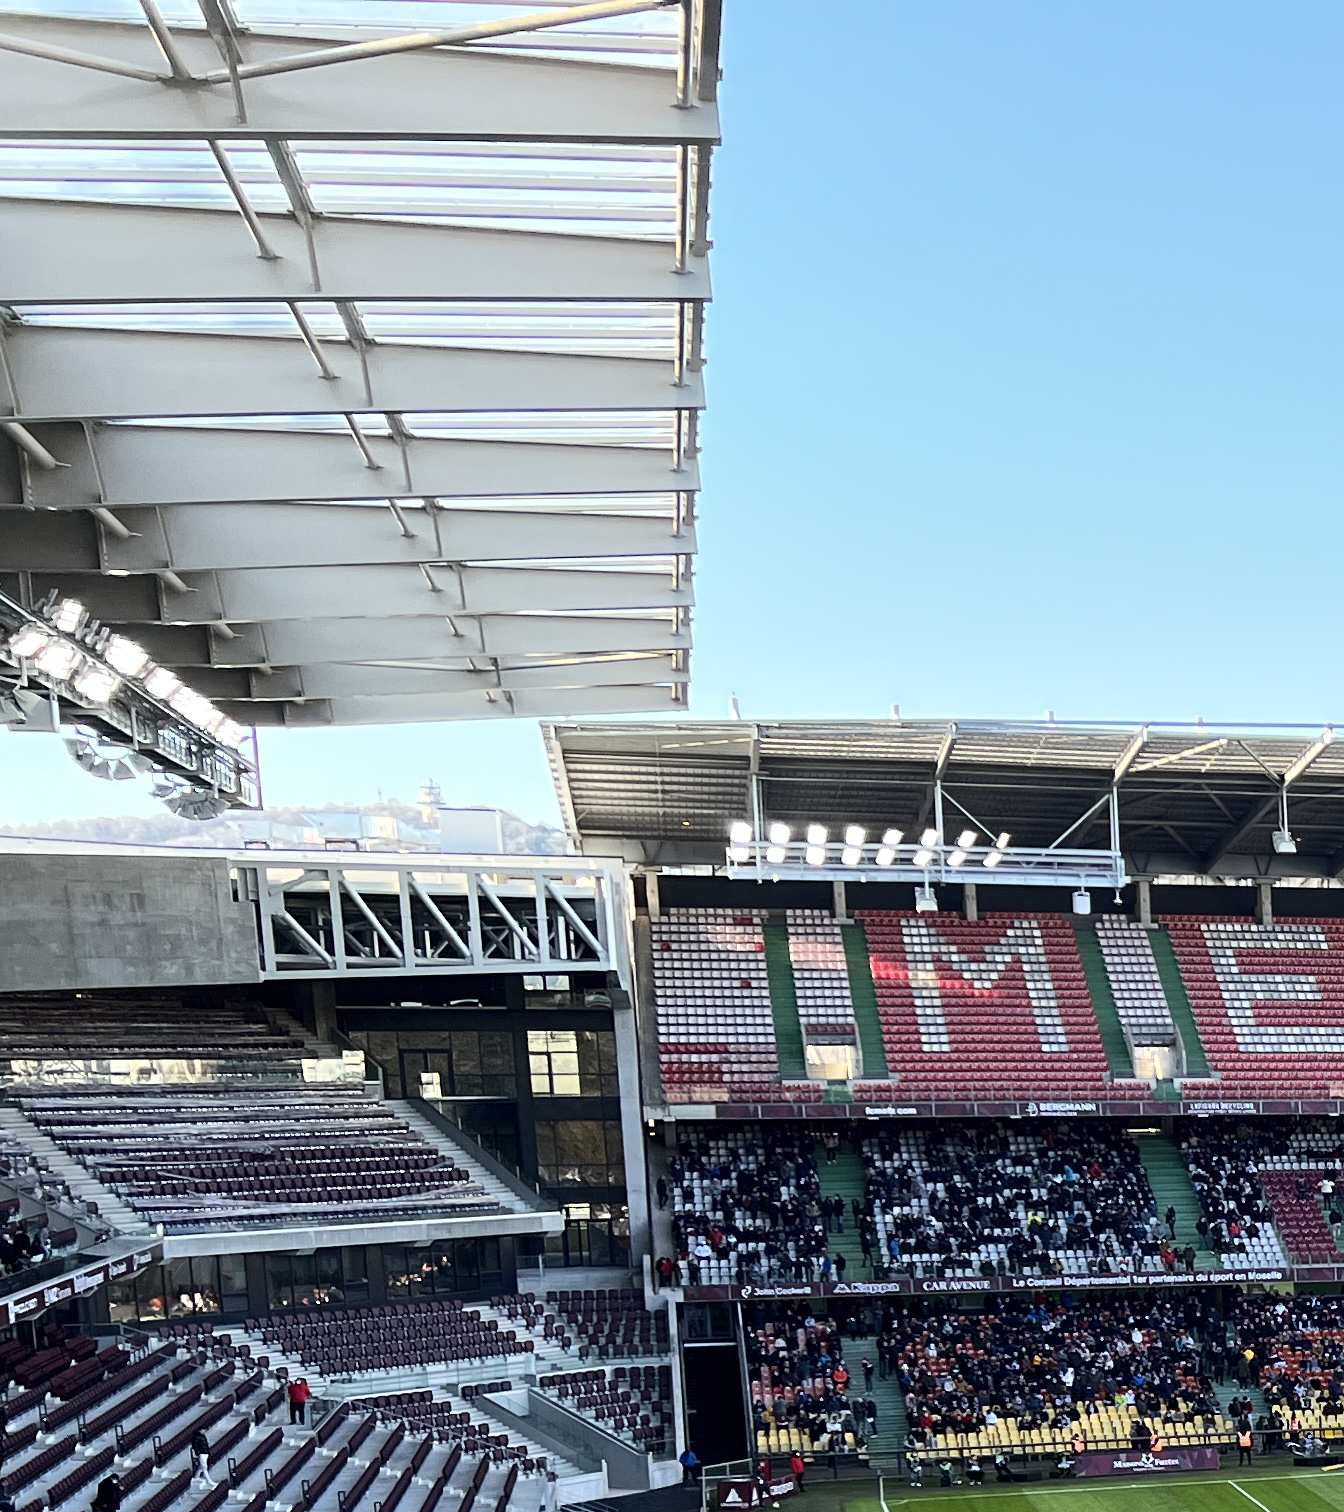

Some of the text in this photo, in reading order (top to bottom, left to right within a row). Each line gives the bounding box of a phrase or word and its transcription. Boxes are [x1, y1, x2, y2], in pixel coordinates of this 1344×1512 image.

[1040, 1103, 1096, 1112] BERGMANN
[923, 1280, 991, 1291] CAR AVENUE
[1012, 1278, 1024, 1288] Le
[1026, 1277, 1062, 1287] Conseil
[1064, 1274, 1130, 1286] Départemental
[1149, 1273, 1193, 1285] partenaire
[1196, 1272, 1208, 1282] du
[1209, 1272, 1233, 1283] sport
[1235, 1272, 1246, 1281] en
